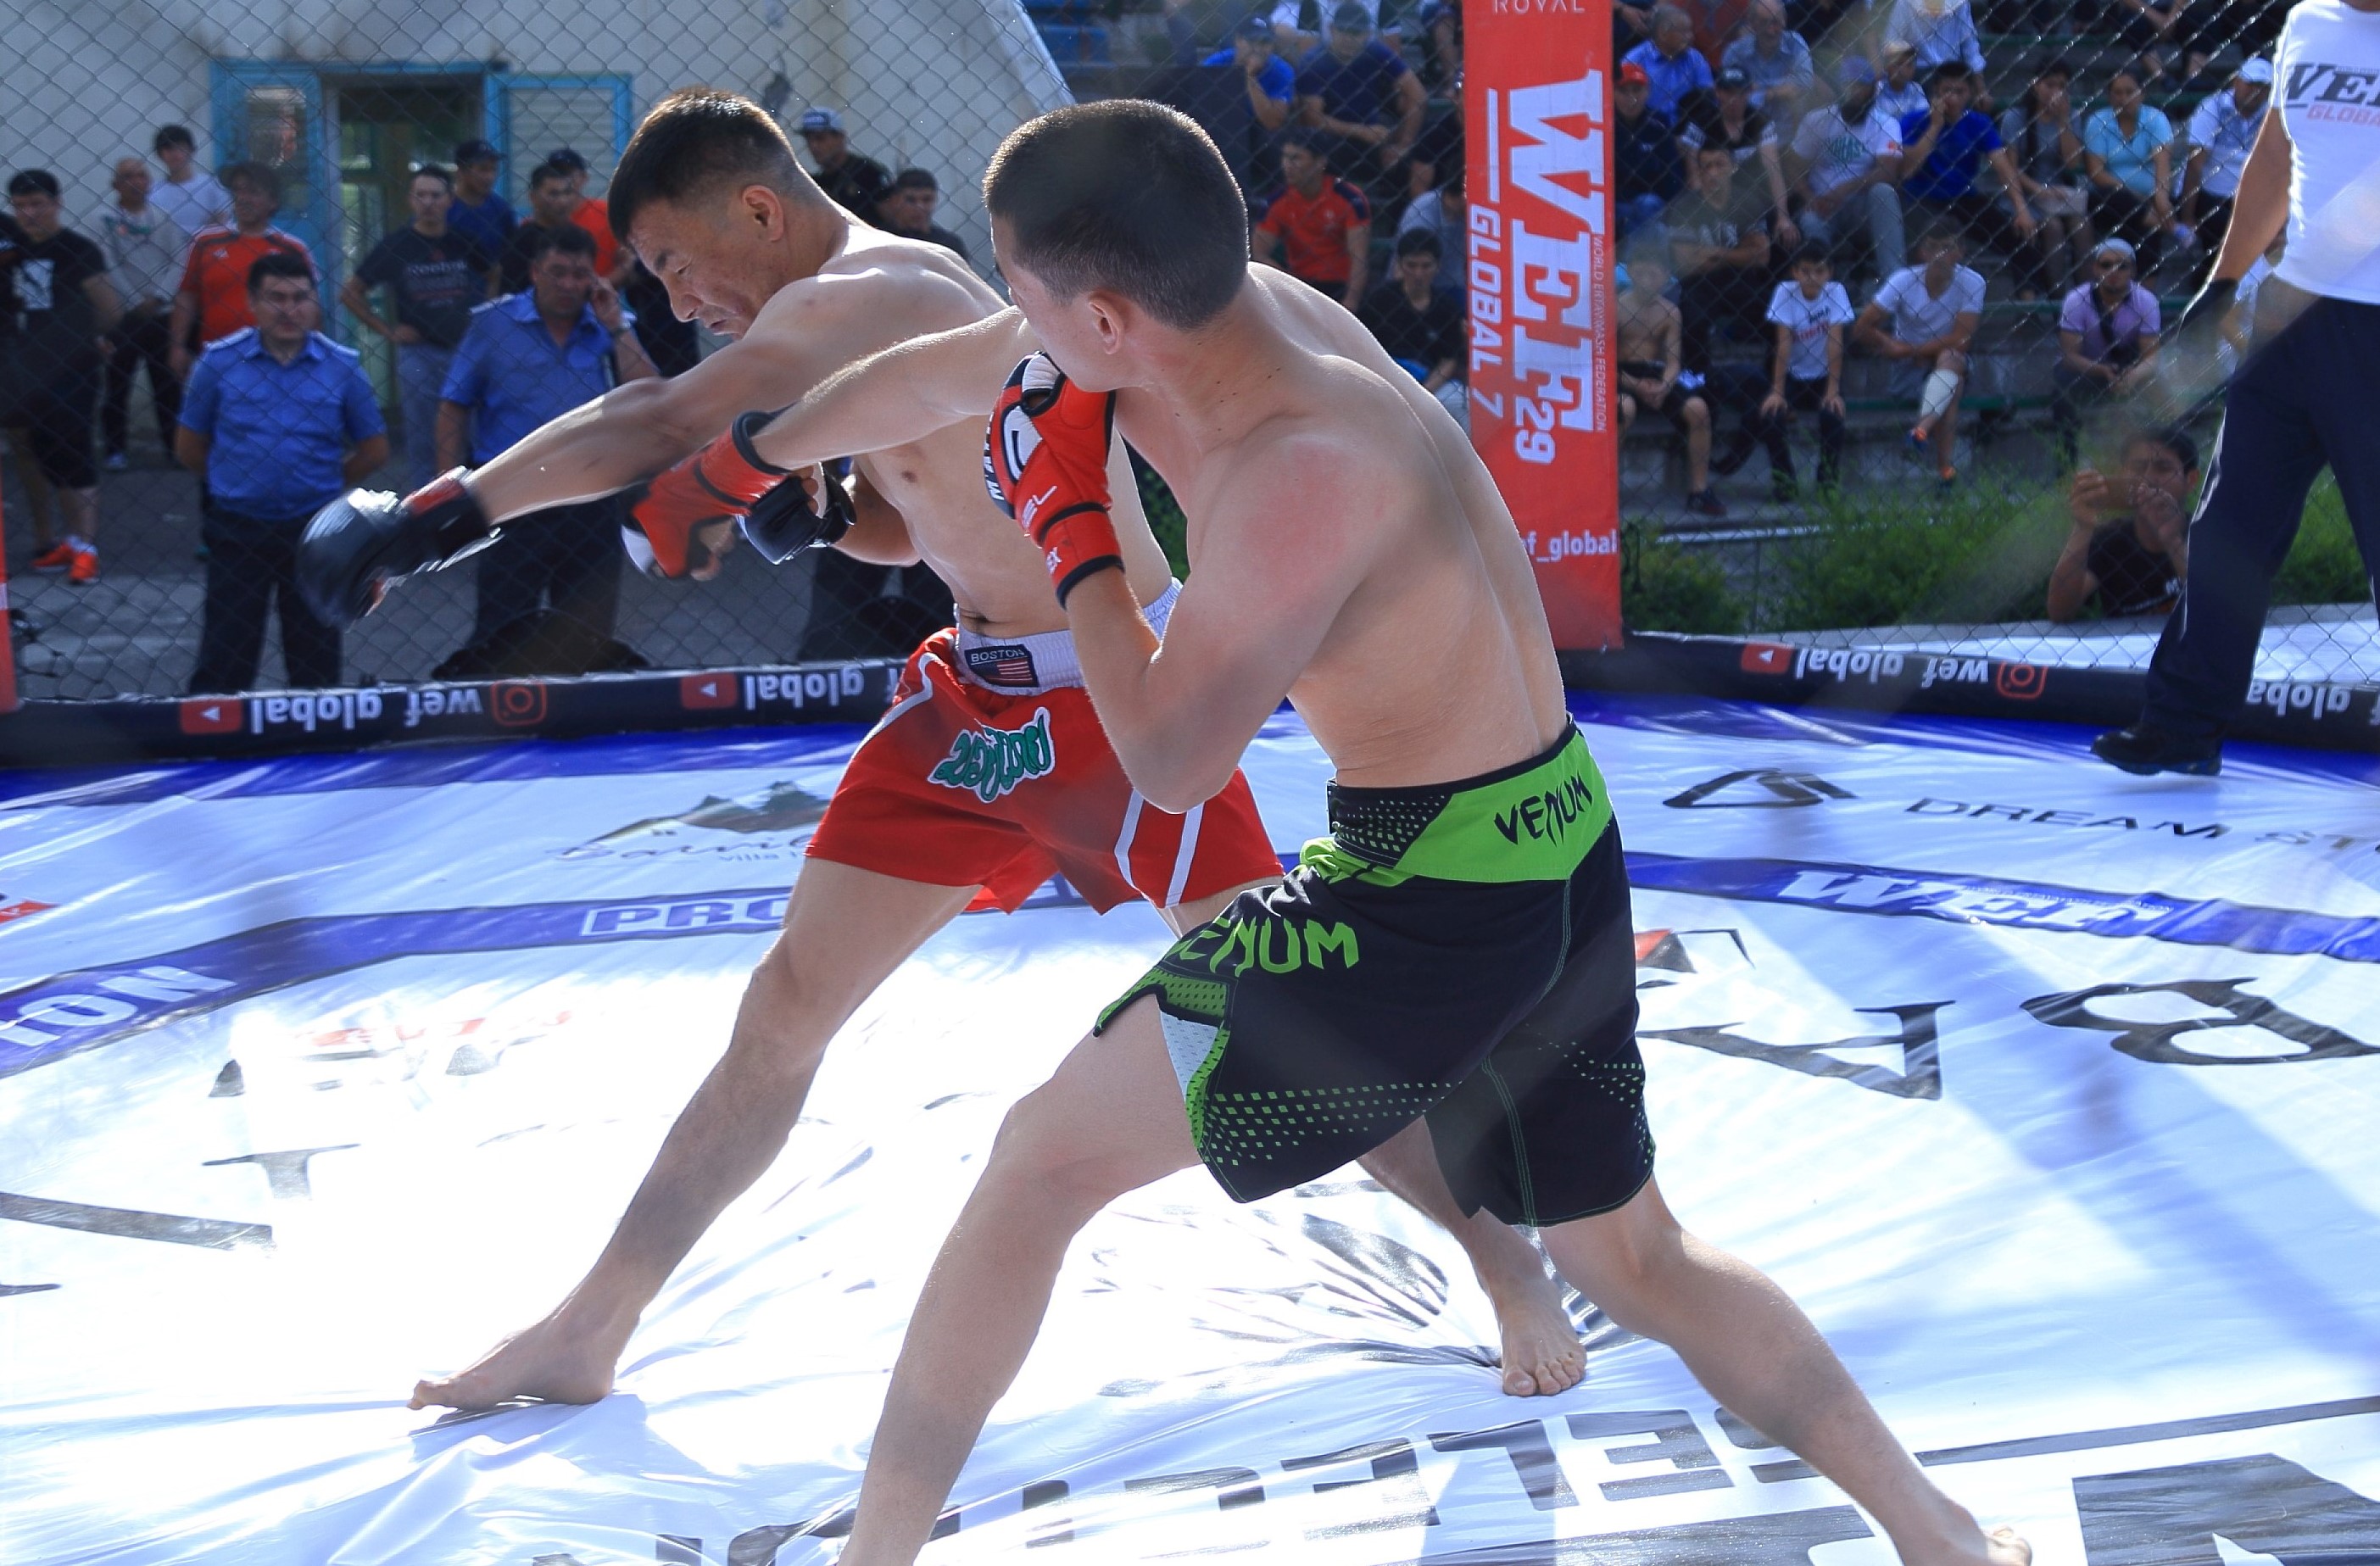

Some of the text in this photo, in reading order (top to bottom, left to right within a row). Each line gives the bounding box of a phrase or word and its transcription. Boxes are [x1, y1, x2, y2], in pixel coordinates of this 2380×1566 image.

[1508, 69, 1605, 464] WEF 29
[1593, 234, 1605, 281] WORLD
[1469, 203, 1503, 418] GLOBAL 7
[1596, 357, 1608, 433] FEDERATION
[1526, 529, 1618, 563] f_global
[971, 649, 1026, 662] BOSTON
[1494, 769, 1593, 848] VENUM
[1906, 797, 2380, 855] DREAM ST
